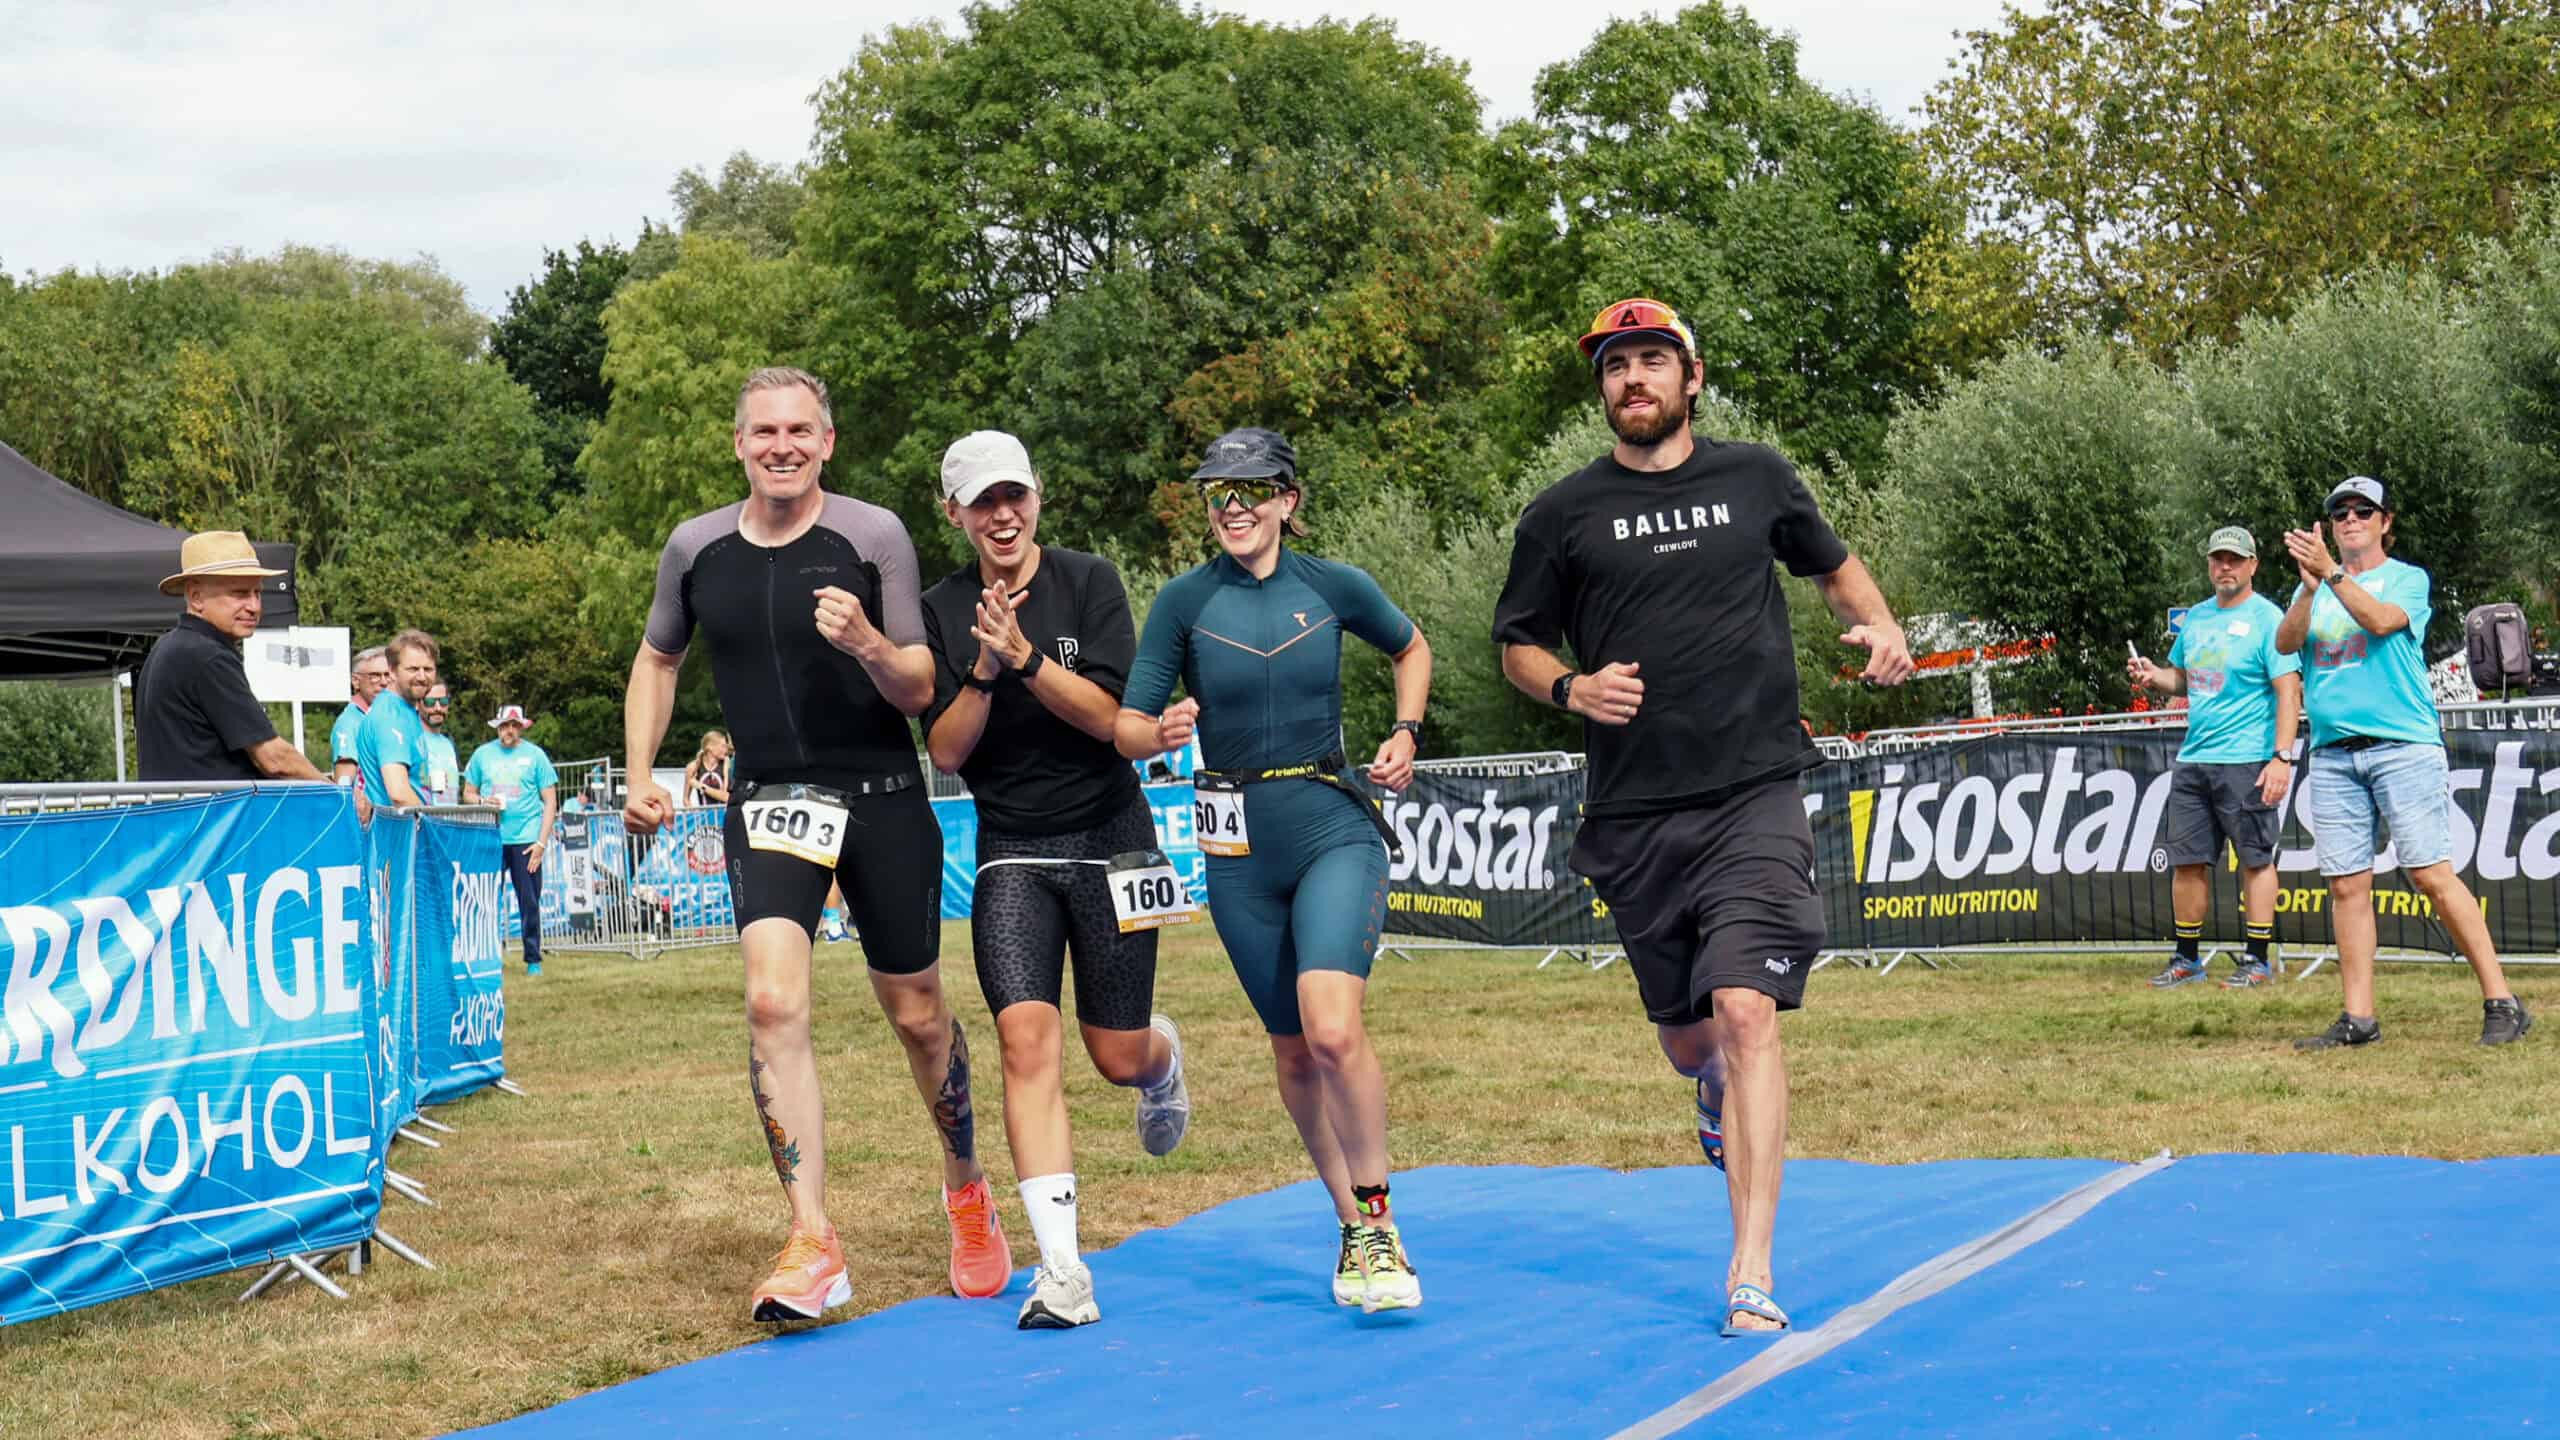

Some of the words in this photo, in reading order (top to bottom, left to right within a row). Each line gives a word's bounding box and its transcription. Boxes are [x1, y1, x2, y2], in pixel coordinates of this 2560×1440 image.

[1613, 503, 1730, 540] BALLRN
[1653, 539, 1698, 554] CREWLOVE
[749, 806, 810, 840] 160
[817, 823, 835, 847] 3
[1225, 812, 1239, 835] 4
[1122, 876, 1174, 912] 160
[1387, 891, 1412, 912] ORT
[1414, 893, 1483, 919] NUTRITION
[1864, 895, 1927, 919] SPORT
[1930, 888, 2038, 917] NUTRITION
[0, 865, 362, 1078] RDINGE
[0, 1072, 371, 1222] LKOHOL
